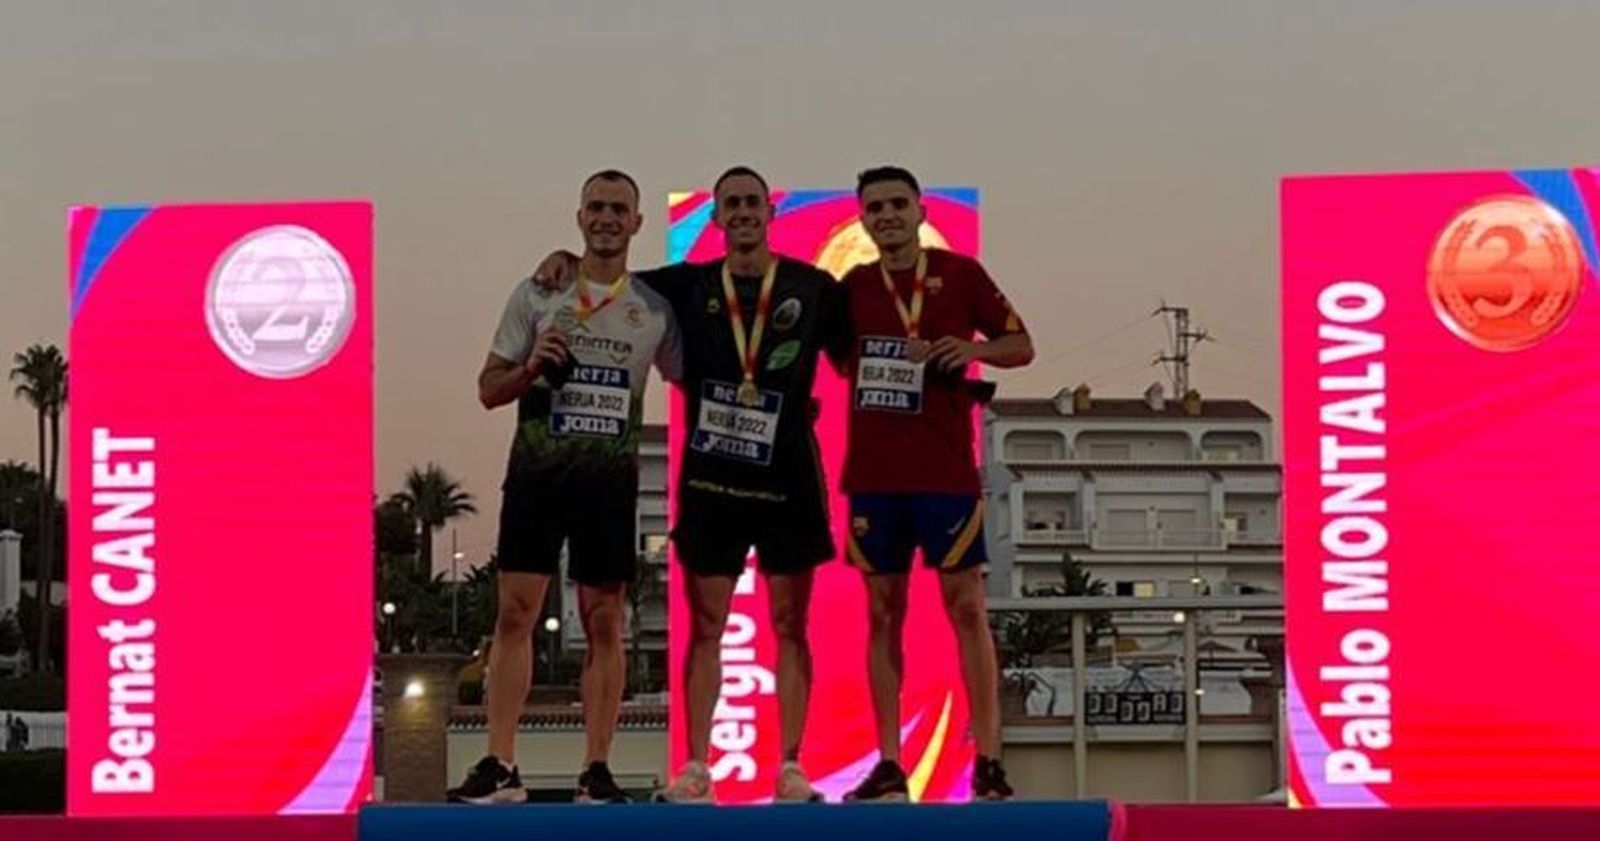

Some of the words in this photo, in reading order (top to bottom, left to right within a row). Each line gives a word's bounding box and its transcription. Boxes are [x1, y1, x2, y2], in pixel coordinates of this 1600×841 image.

[252, 256, 310, 341] 2
[1475, 225, 1533, 319] 3
[597, 394, 625, 412] 2022
[738, 416, 768, 434] 2022
[1317, 281, 1389, 611] MONTALVO
[92, 428, 155, 609] CANET
[92, 619, 155, 794] Bernat
[1321, 629, 1392, 786] Pablo
